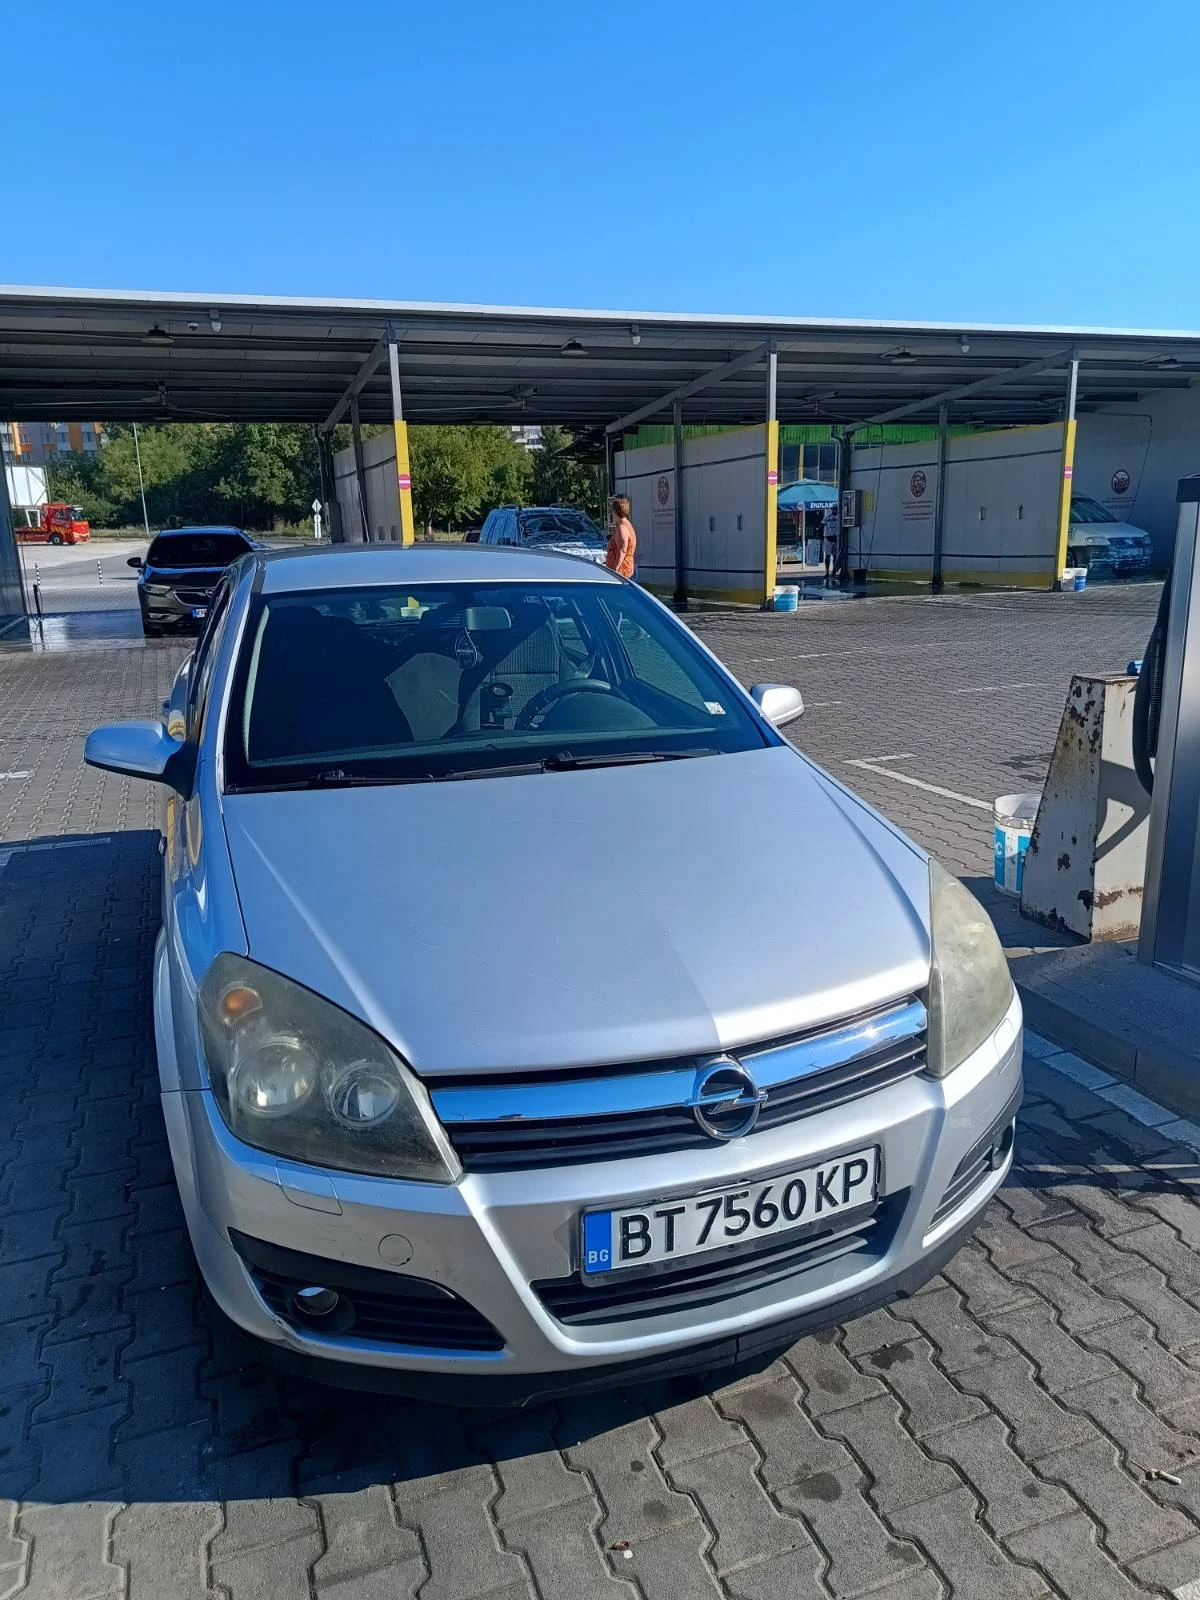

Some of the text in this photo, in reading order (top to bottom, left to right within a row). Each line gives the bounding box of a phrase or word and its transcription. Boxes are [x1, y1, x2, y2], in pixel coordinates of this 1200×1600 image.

[620, 1158, 869, 1260] BT 7560 KP
[588, 1249, 609, 1264] BG
